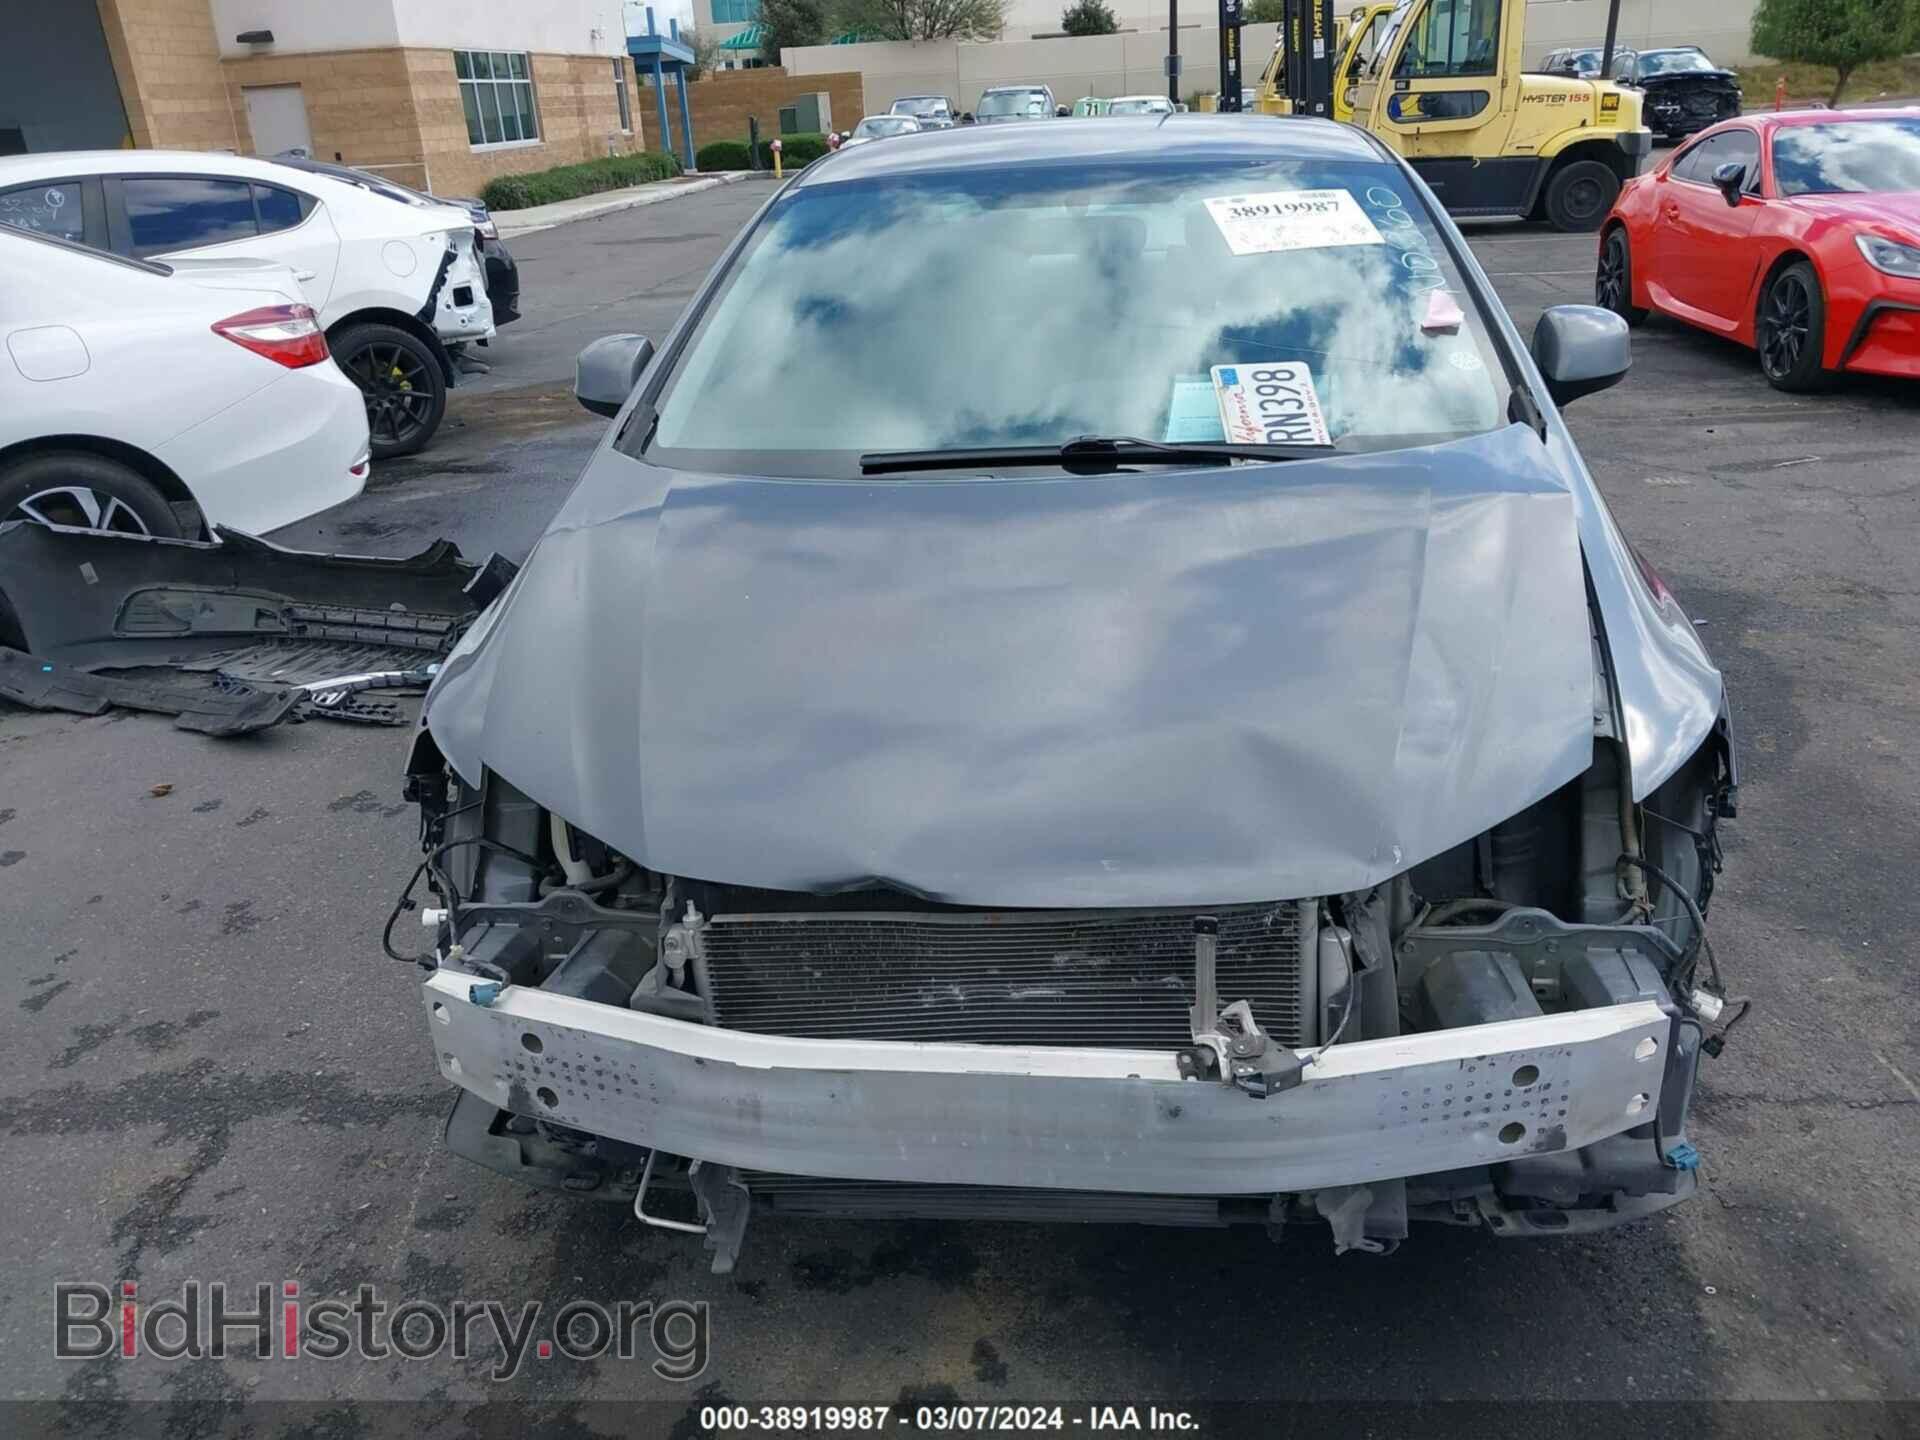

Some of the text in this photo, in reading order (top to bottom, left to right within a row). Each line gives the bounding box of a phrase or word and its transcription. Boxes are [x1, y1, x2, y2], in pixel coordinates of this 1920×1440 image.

[1522, 94, 1567, 104] HYSTER
[1568, 93, 1591, 102] 155
[1086, 103, 1098, 116] 71
[1228, 200, 1339, 219] 38919987
[1251, 369, 1315, 443] RN398
